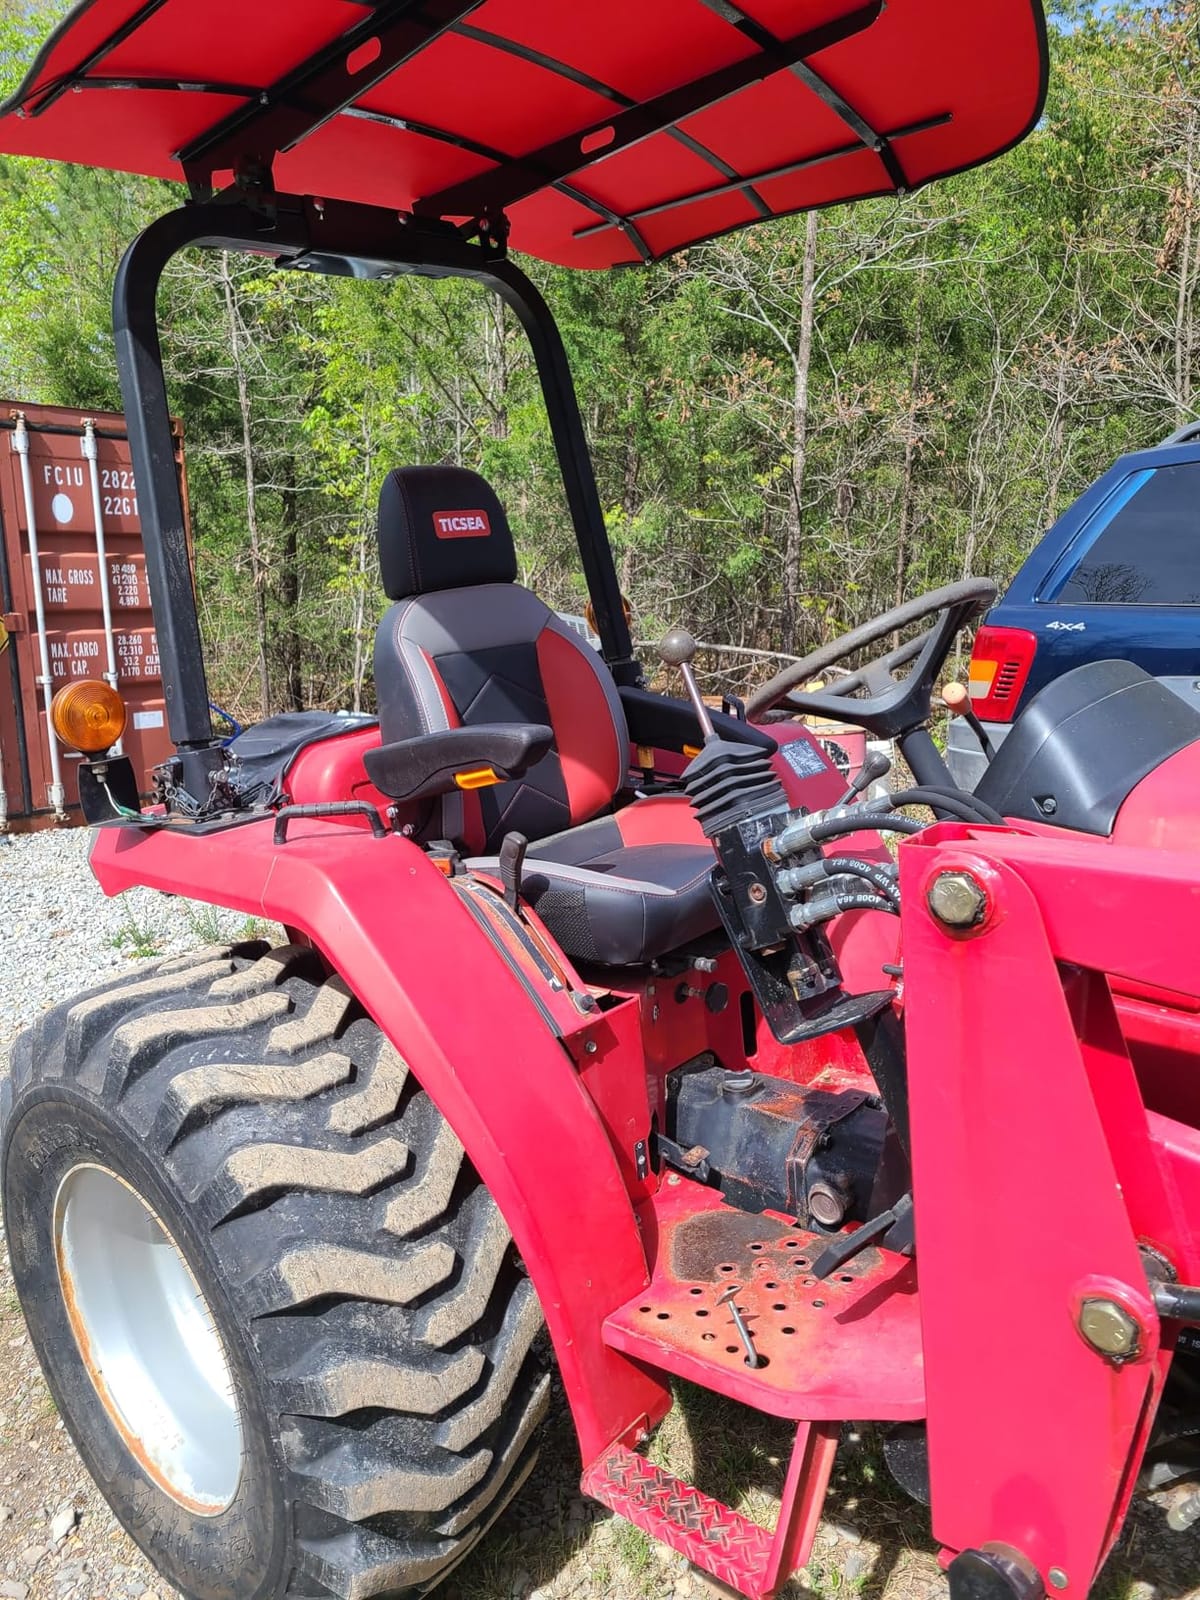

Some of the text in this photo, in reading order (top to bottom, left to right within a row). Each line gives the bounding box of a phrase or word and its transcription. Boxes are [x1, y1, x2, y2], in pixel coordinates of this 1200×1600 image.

[44, 465, 84, 487] FCIU
[438, 516, 486, 532] TICSEA
[45, 568, 66, 585] MAX.
[68, 568, 94, 585] GROSS
[47, 587, 68, 604] TARE
[50, 642, 72, 658] MAX.
[73, 641, 99, 657] CARGO
[53, 661, 67, 677] CU.
[71, 660, 90, 675] CAP.
